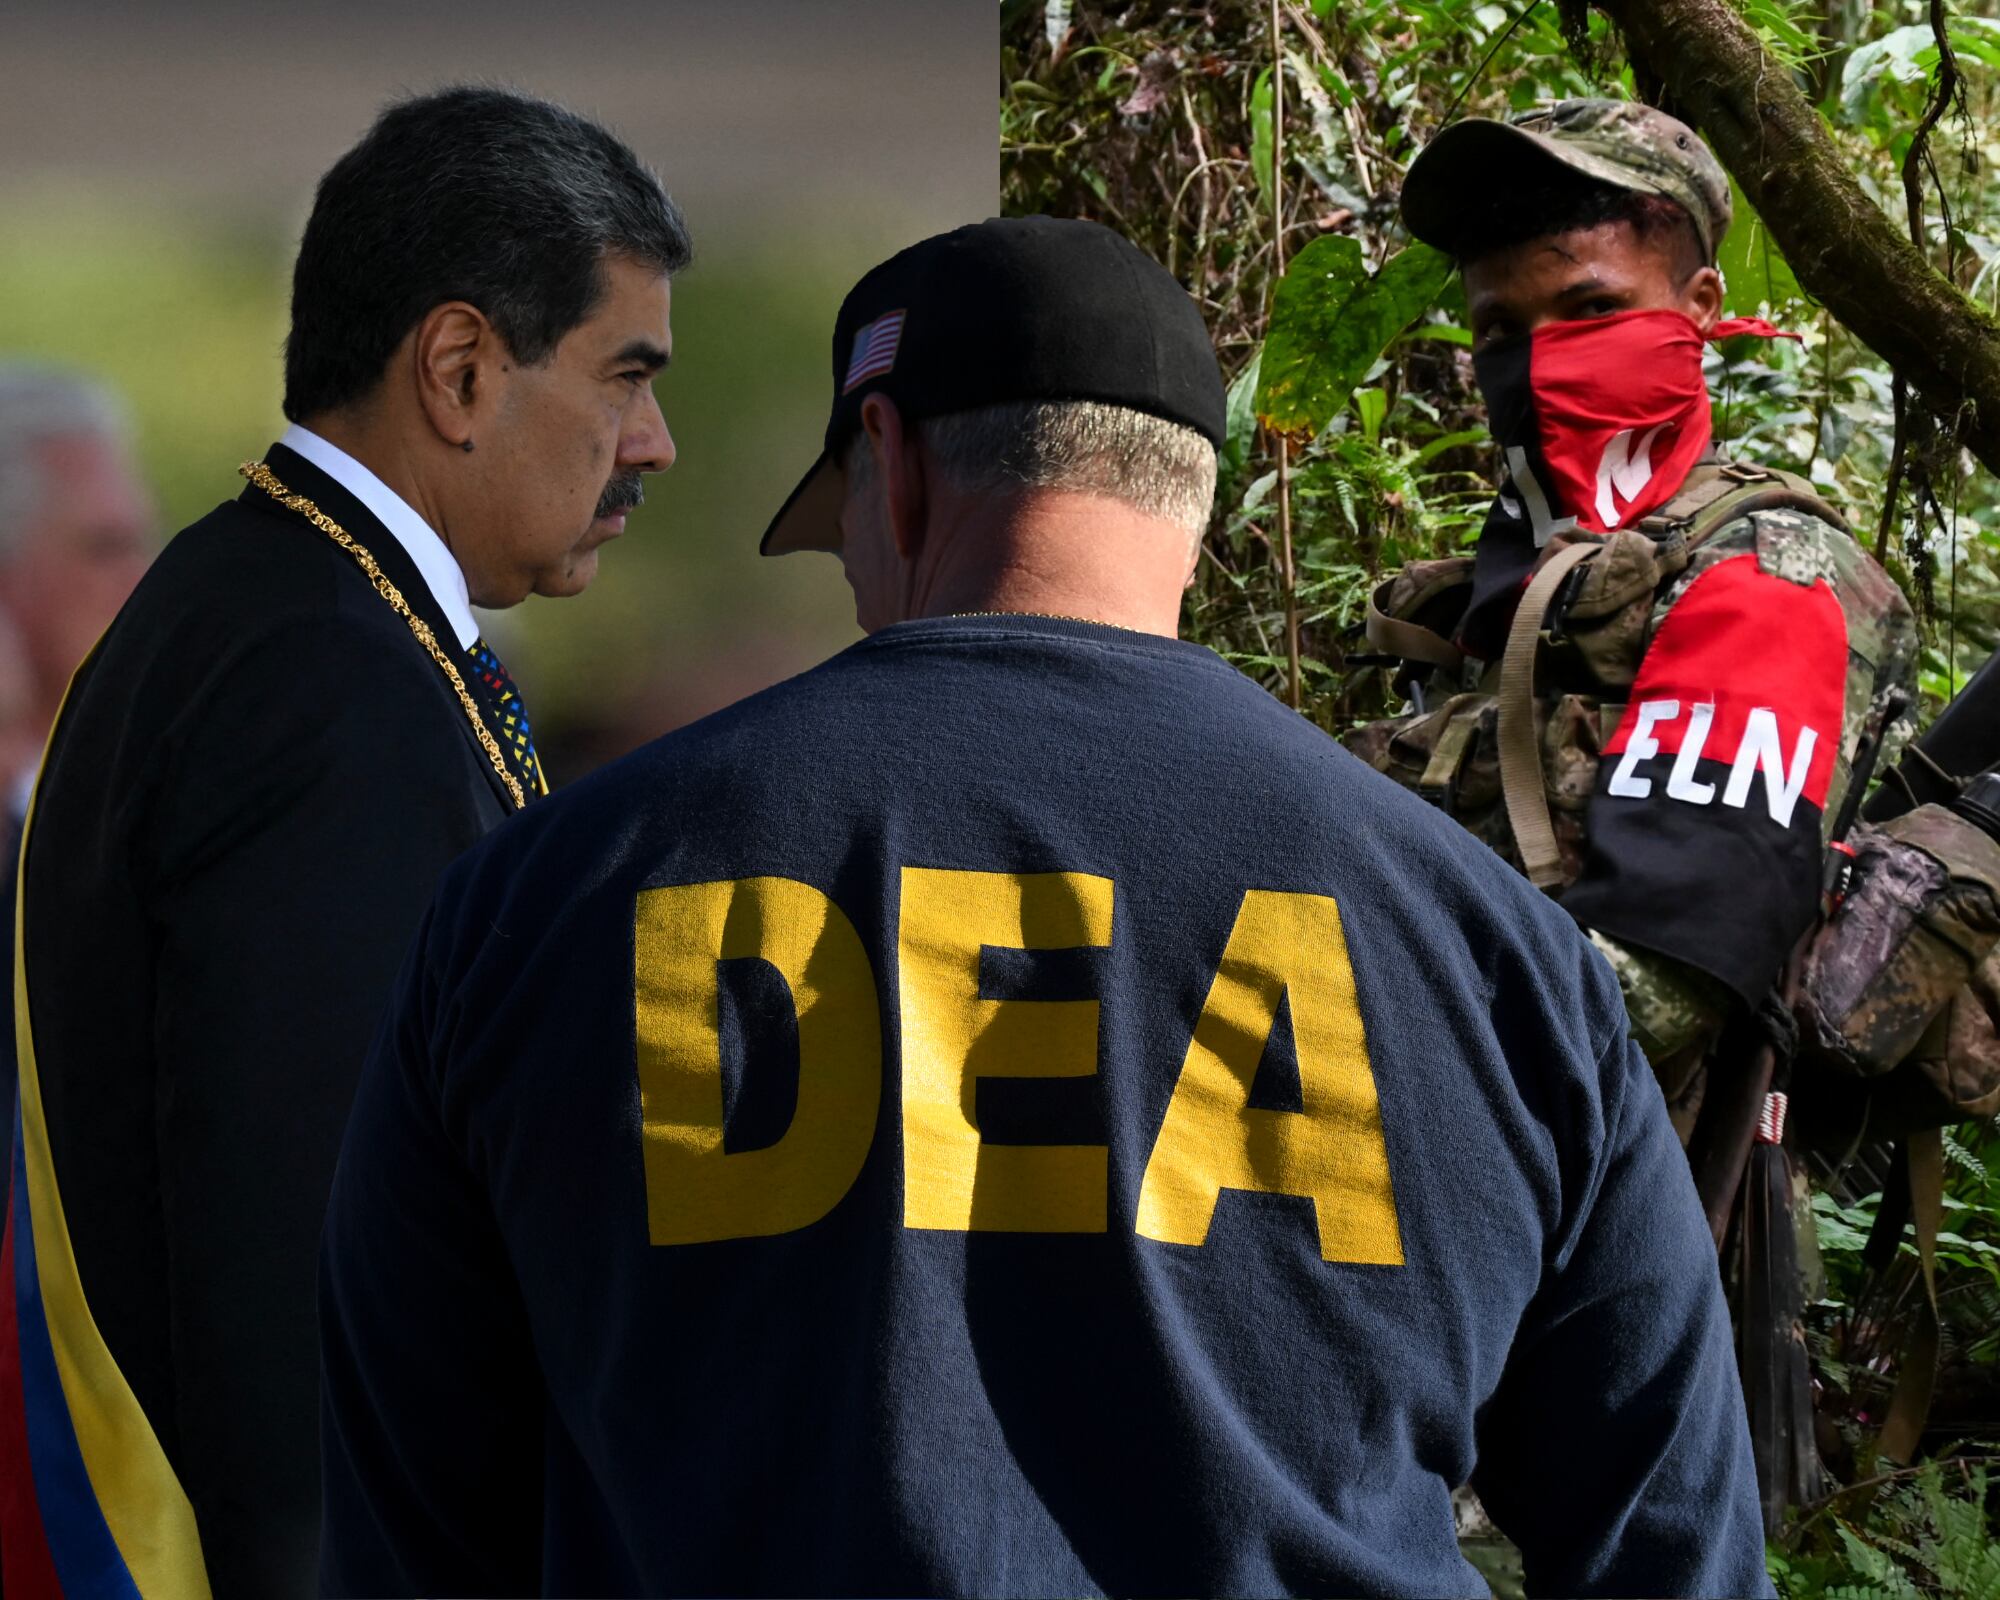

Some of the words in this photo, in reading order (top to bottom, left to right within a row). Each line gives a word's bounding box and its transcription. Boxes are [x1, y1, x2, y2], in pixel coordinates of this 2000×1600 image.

[1501, 421, 1675, 549] LN
[1608, 699, 1818, 828] ELN
[634, 866, 1405, 1265] DEA
